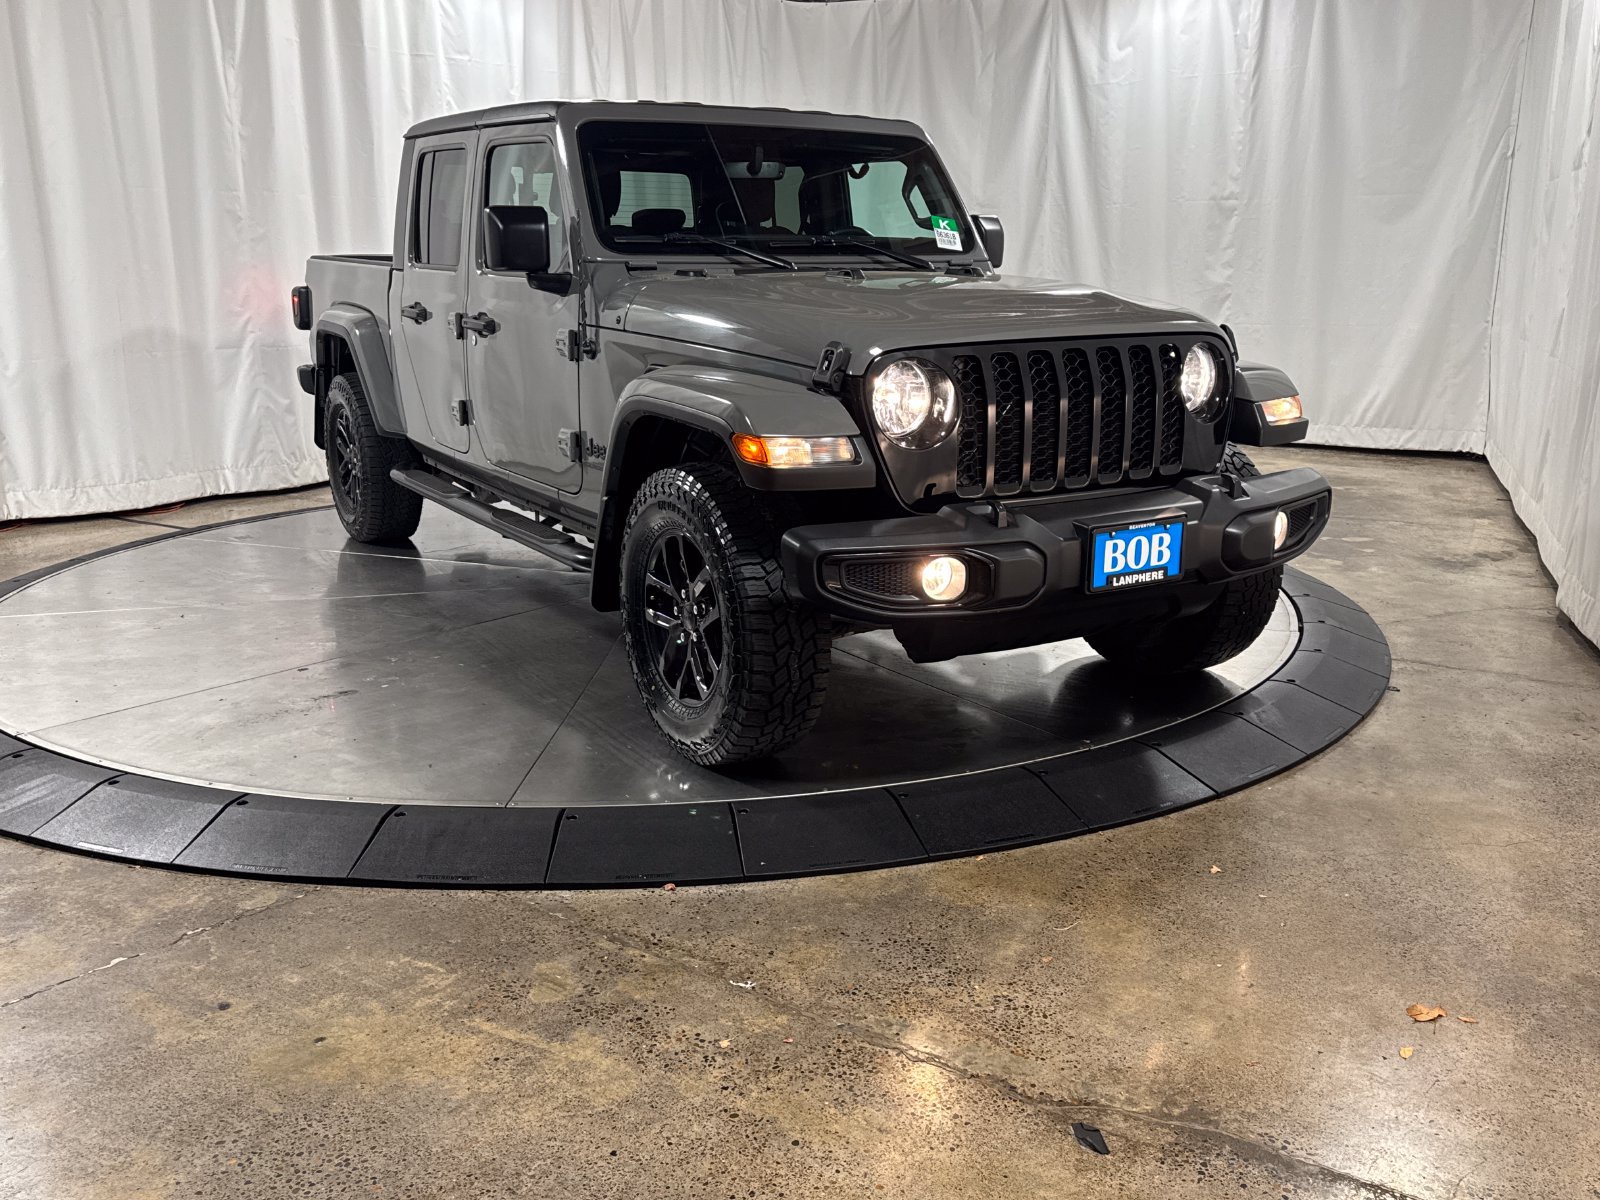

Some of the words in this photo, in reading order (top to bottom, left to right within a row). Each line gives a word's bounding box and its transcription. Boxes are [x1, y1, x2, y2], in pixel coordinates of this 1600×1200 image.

[939, 219, 951, 230] K
[1104, 533, 1171, 573] BOB
[1113, 570, 1164, 587] LANPHERE
